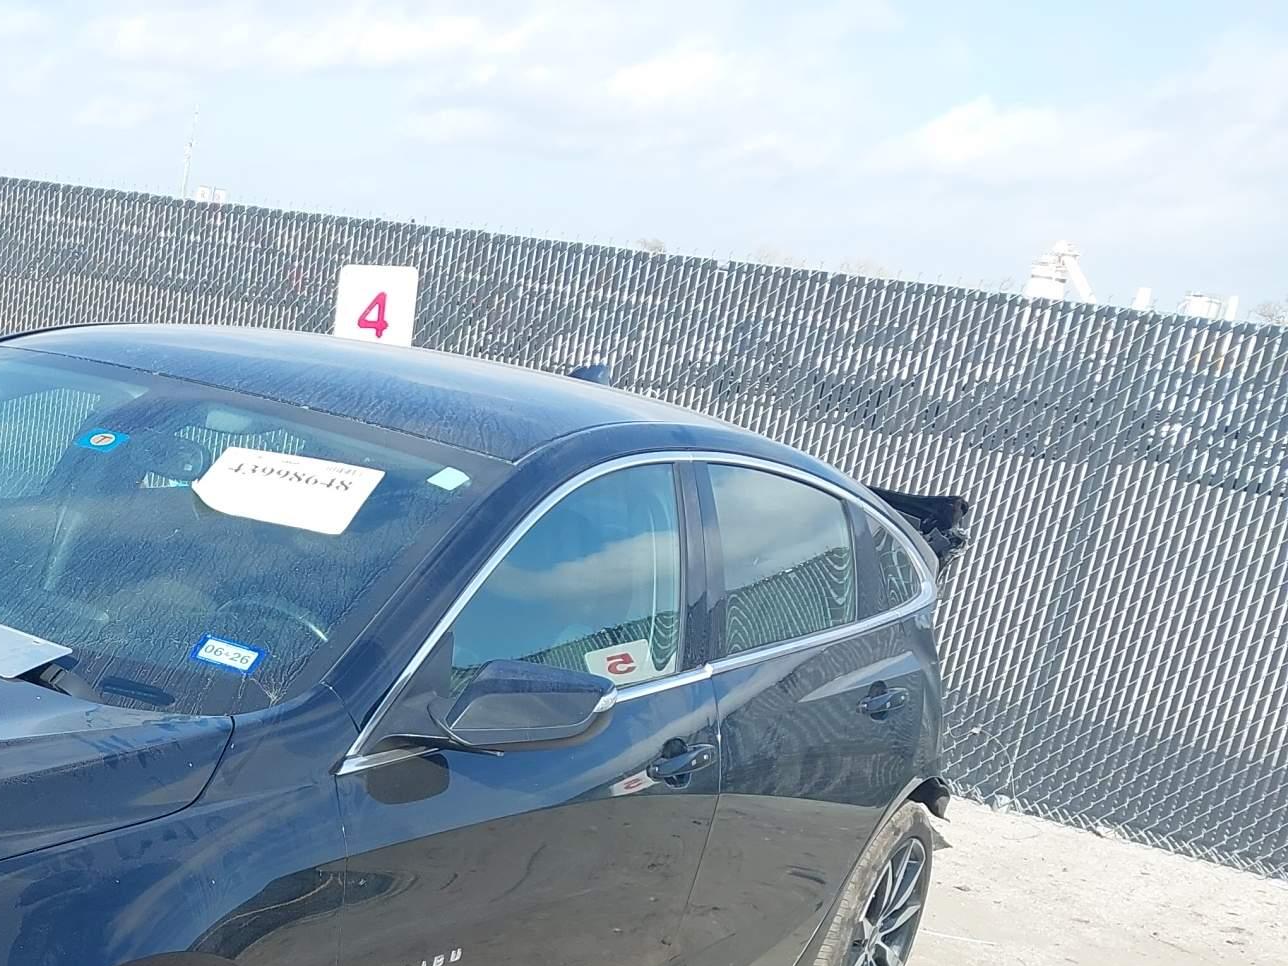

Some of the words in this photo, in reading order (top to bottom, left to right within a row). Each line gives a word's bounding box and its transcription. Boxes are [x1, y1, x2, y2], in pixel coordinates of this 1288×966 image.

[357, 291, 389, 338] 4
[227, 462, 354, 492] 43998648
[204, 644, 251, 665] 06-26
